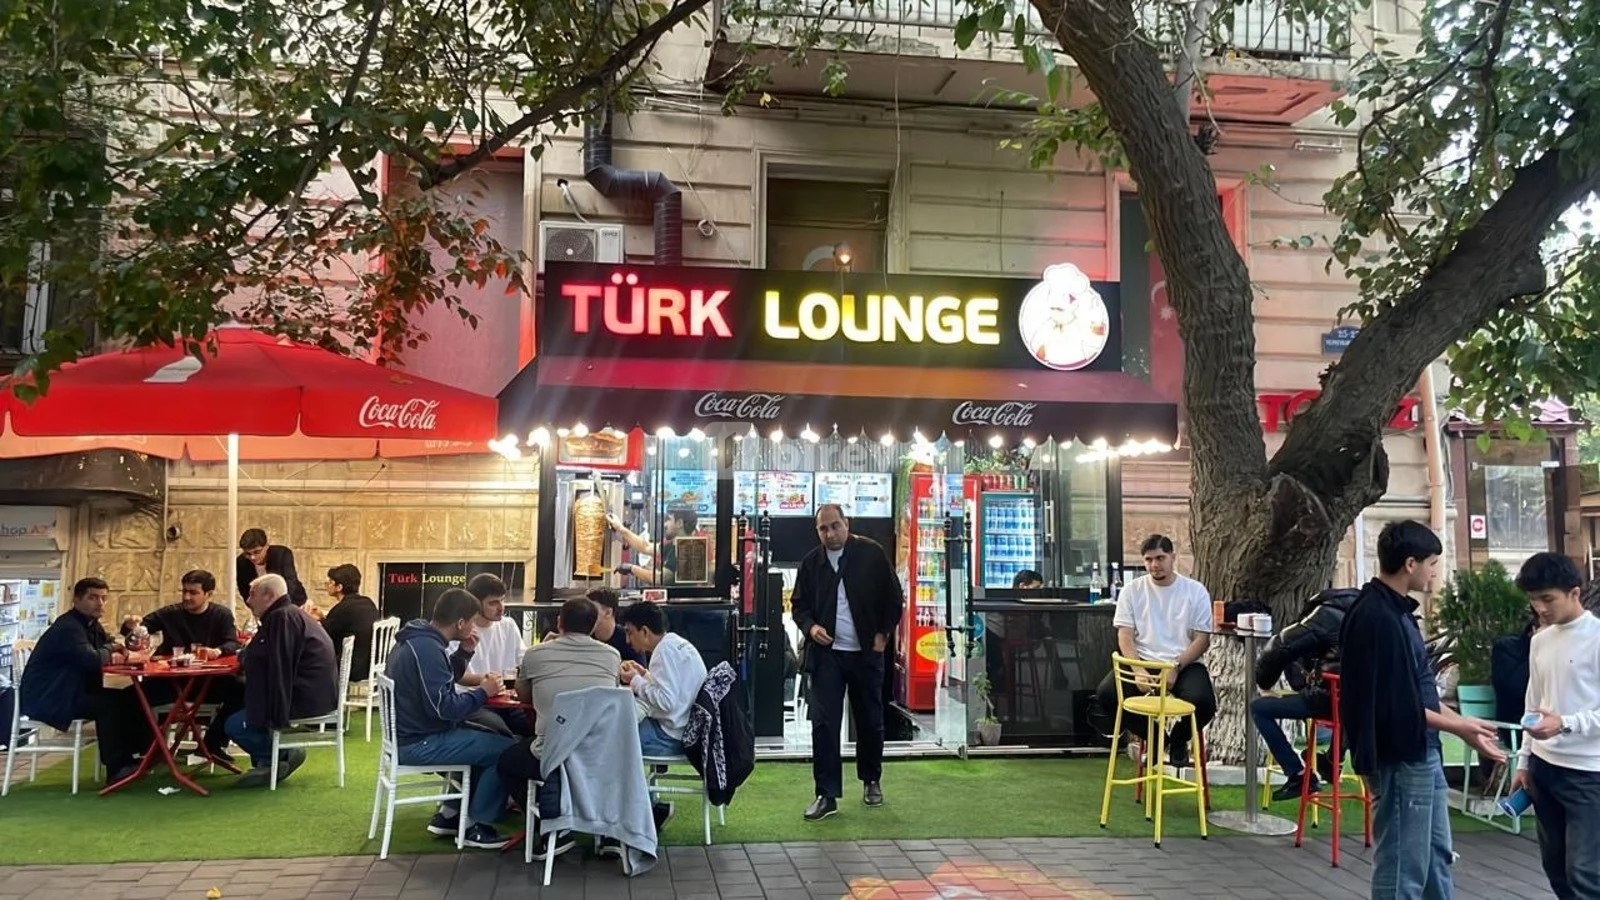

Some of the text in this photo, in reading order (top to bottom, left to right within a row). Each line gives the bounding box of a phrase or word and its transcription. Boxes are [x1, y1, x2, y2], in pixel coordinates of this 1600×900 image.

[562, 273, 1001, 344] TÜRK LOUNGE
[421, 573, 466, 585] Lounge
